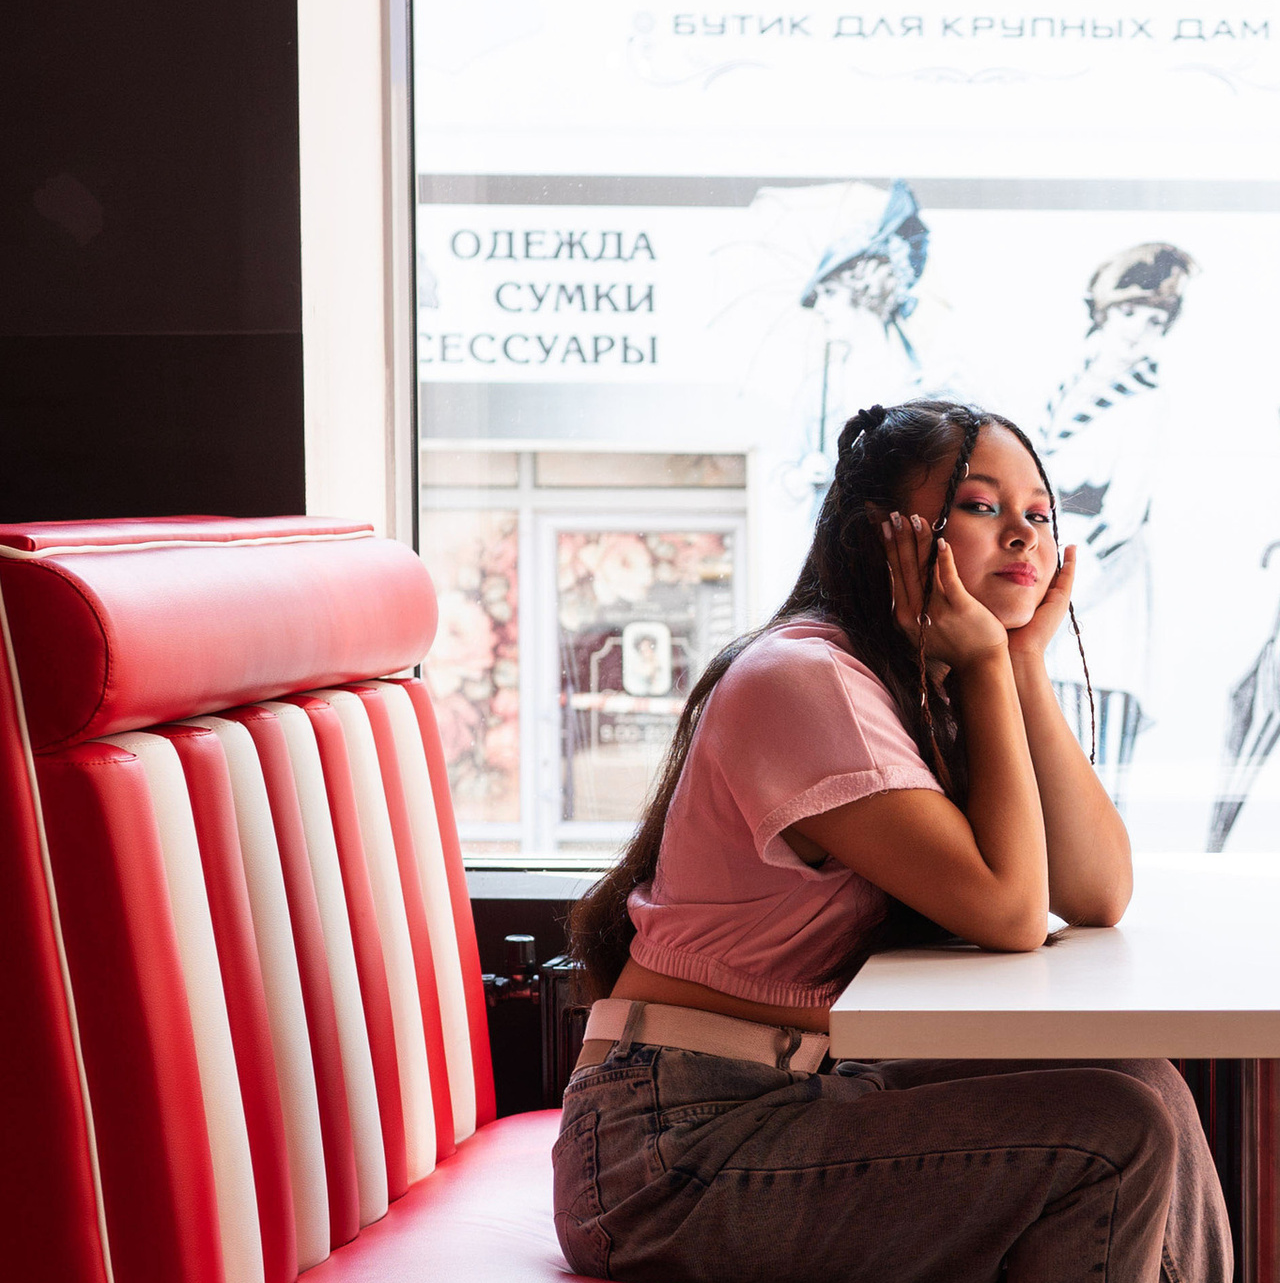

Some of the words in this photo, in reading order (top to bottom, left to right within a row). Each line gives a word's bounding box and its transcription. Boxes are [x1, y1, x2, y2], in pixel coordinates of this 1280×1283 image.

[672, 14, 811, 37] БУТИК
[832, 16, 924, 39] ДЛЯ
[941, 17, 1154, 39] КРУПНЫХ
[1172, 19, 1270, 41] ДАМ
[450, 229, 656, 262] ОДЕЖДА
[494, 281, 655, 313] СУМКИ
